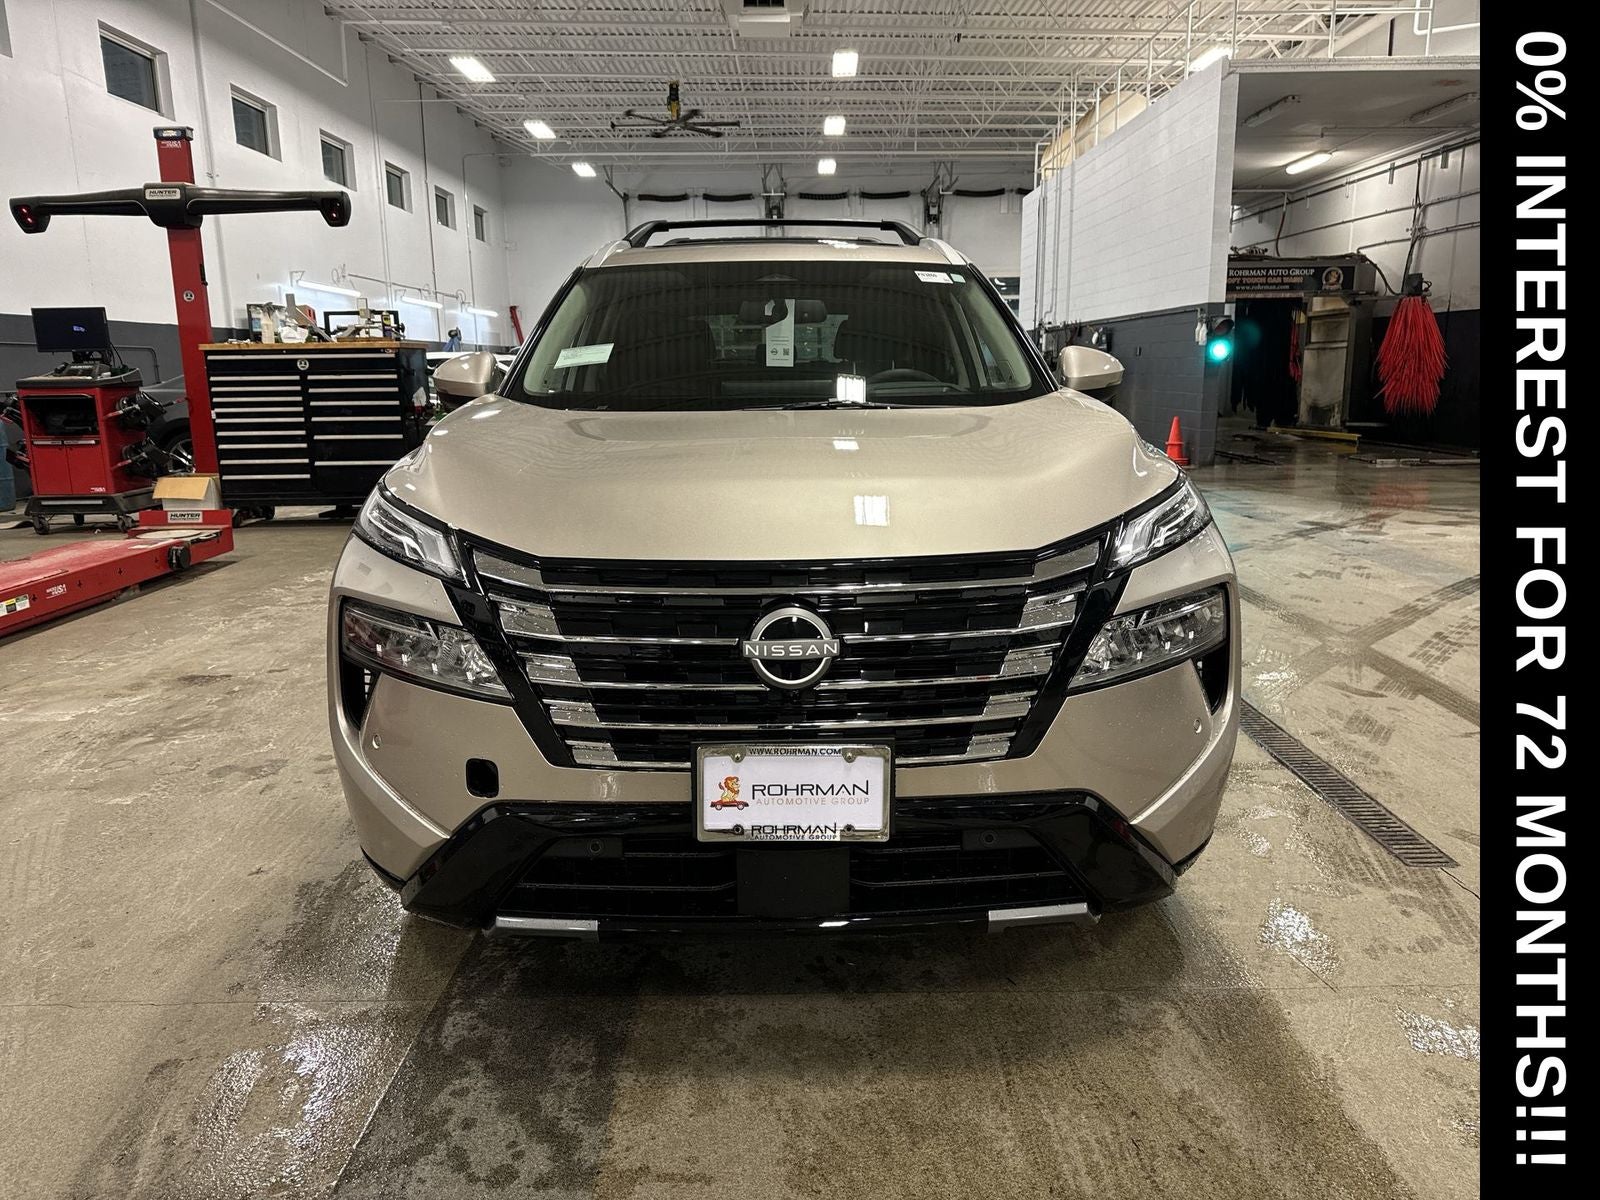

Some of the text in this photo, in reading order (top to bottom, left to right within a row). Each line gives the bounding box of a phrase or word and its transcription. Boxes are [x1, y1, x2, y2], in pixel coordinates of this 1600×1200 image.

[1289, 268, 1315, 276] GROUP
[745, 642, 838, 657] NISSAN
[749, 748, 841, 756] WWW.ROHRMAN.COM
[752, 780, 869, 800] ROHRMAN
[756, 796, 870, 806] AUTOMOTIVE GROUP
[751, 822, 837, 837] ROHRMAN
